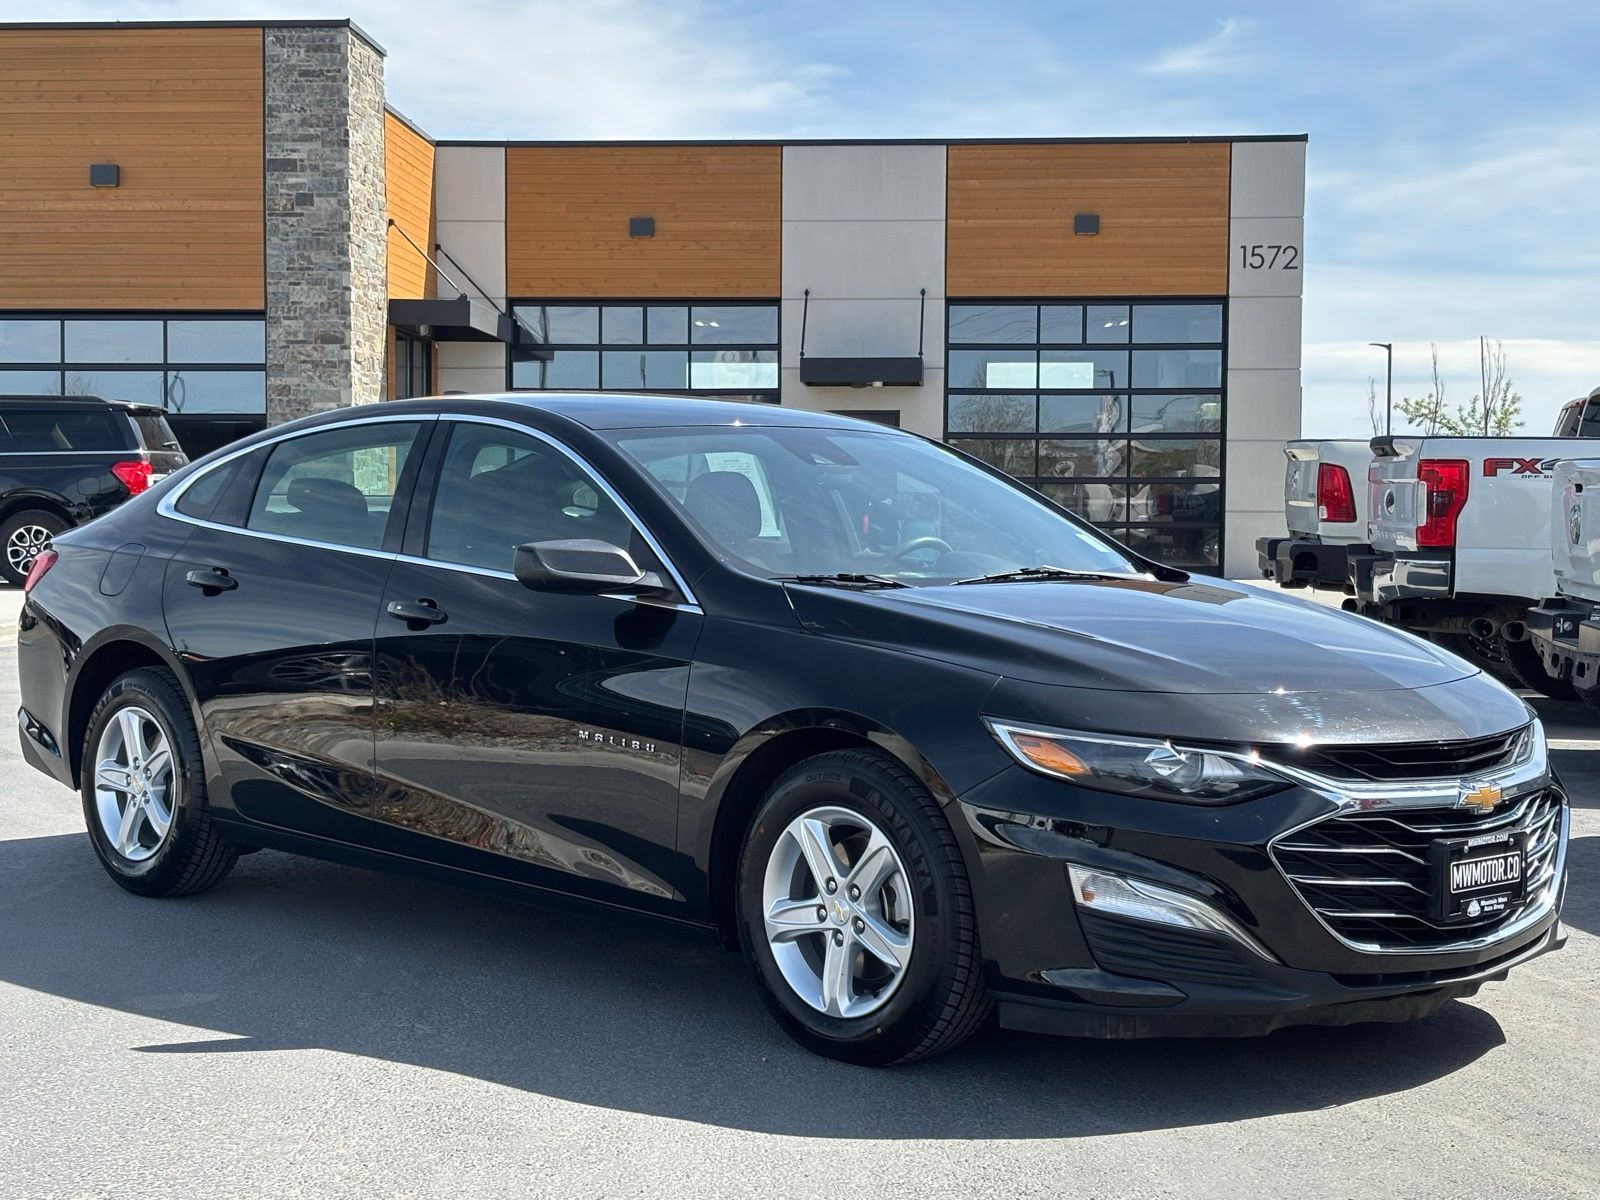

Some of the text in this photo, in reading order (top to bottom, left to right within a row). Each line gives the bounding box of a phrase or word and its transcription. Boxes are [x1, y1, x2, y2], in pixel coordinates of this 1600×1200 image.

[1240, 245, 1298, 270] 1572
[579, 730, 655, 753] MALIBU
[865, 788, 933, 892] ADVANTA
[1454, 856, 1519, 889] MWMOTOR.CO
